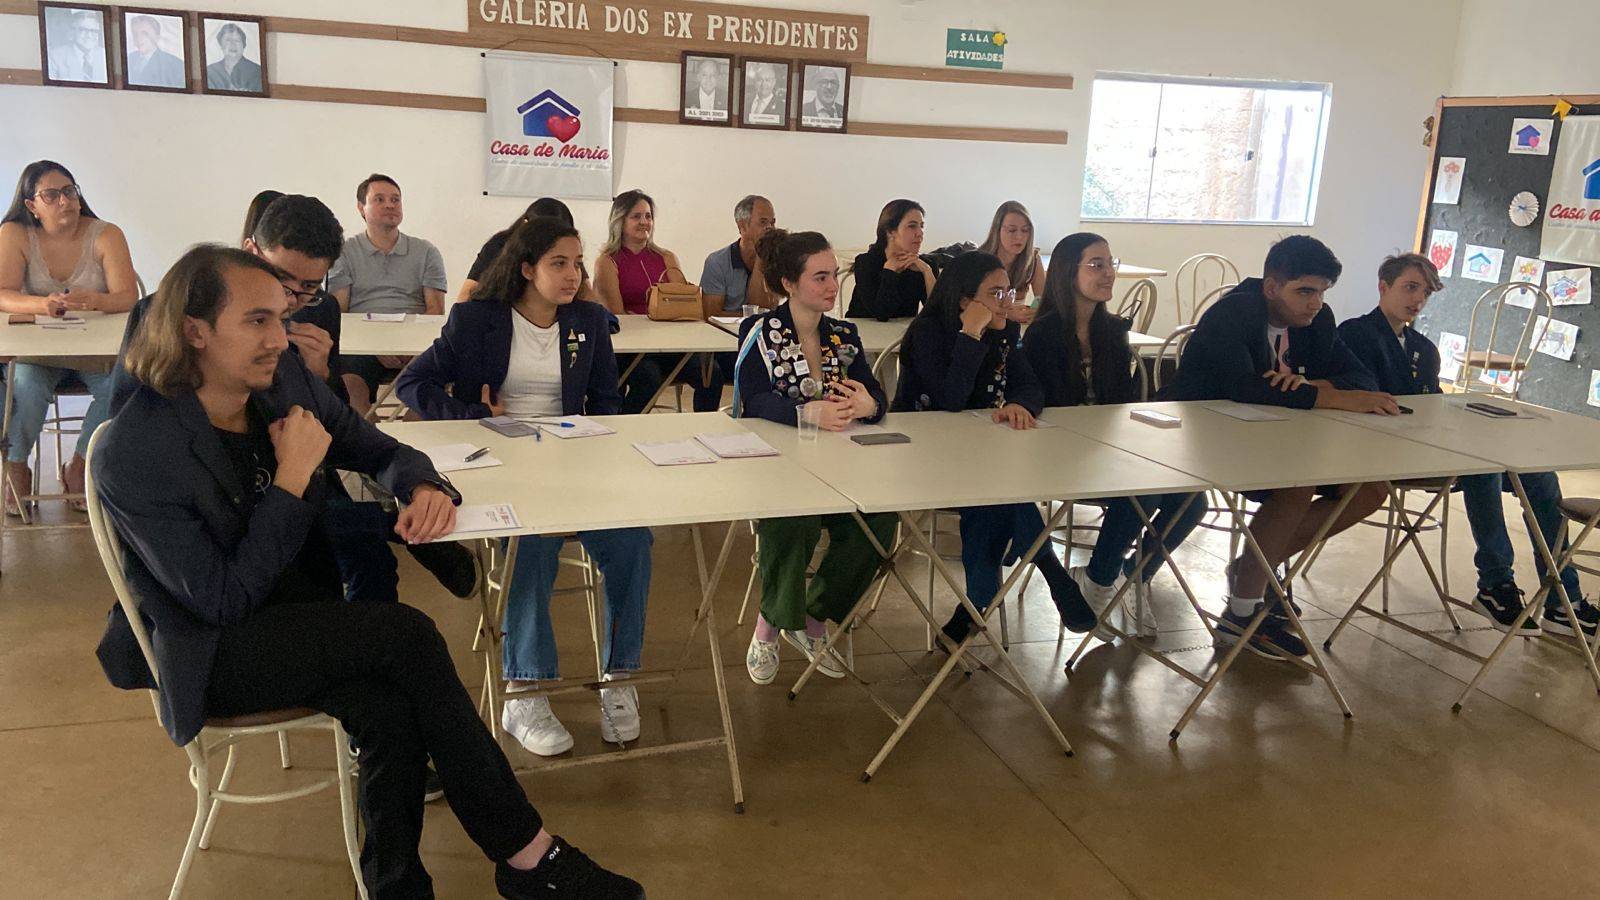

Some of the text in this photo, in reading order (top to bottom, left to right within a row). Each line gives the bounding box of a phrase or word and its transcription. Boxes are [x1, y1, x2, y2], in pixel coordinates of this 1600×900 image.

[479, 0, 858, 51] GALERIA DOS EX PRESIDENTES
[960, 33, 989, 43] SALA
[947, 50, 1004, 62] ATIVIDADES
[490, 140, 610, 160] Casa de Maria
[1549, 203, 1586, 220] Casa
